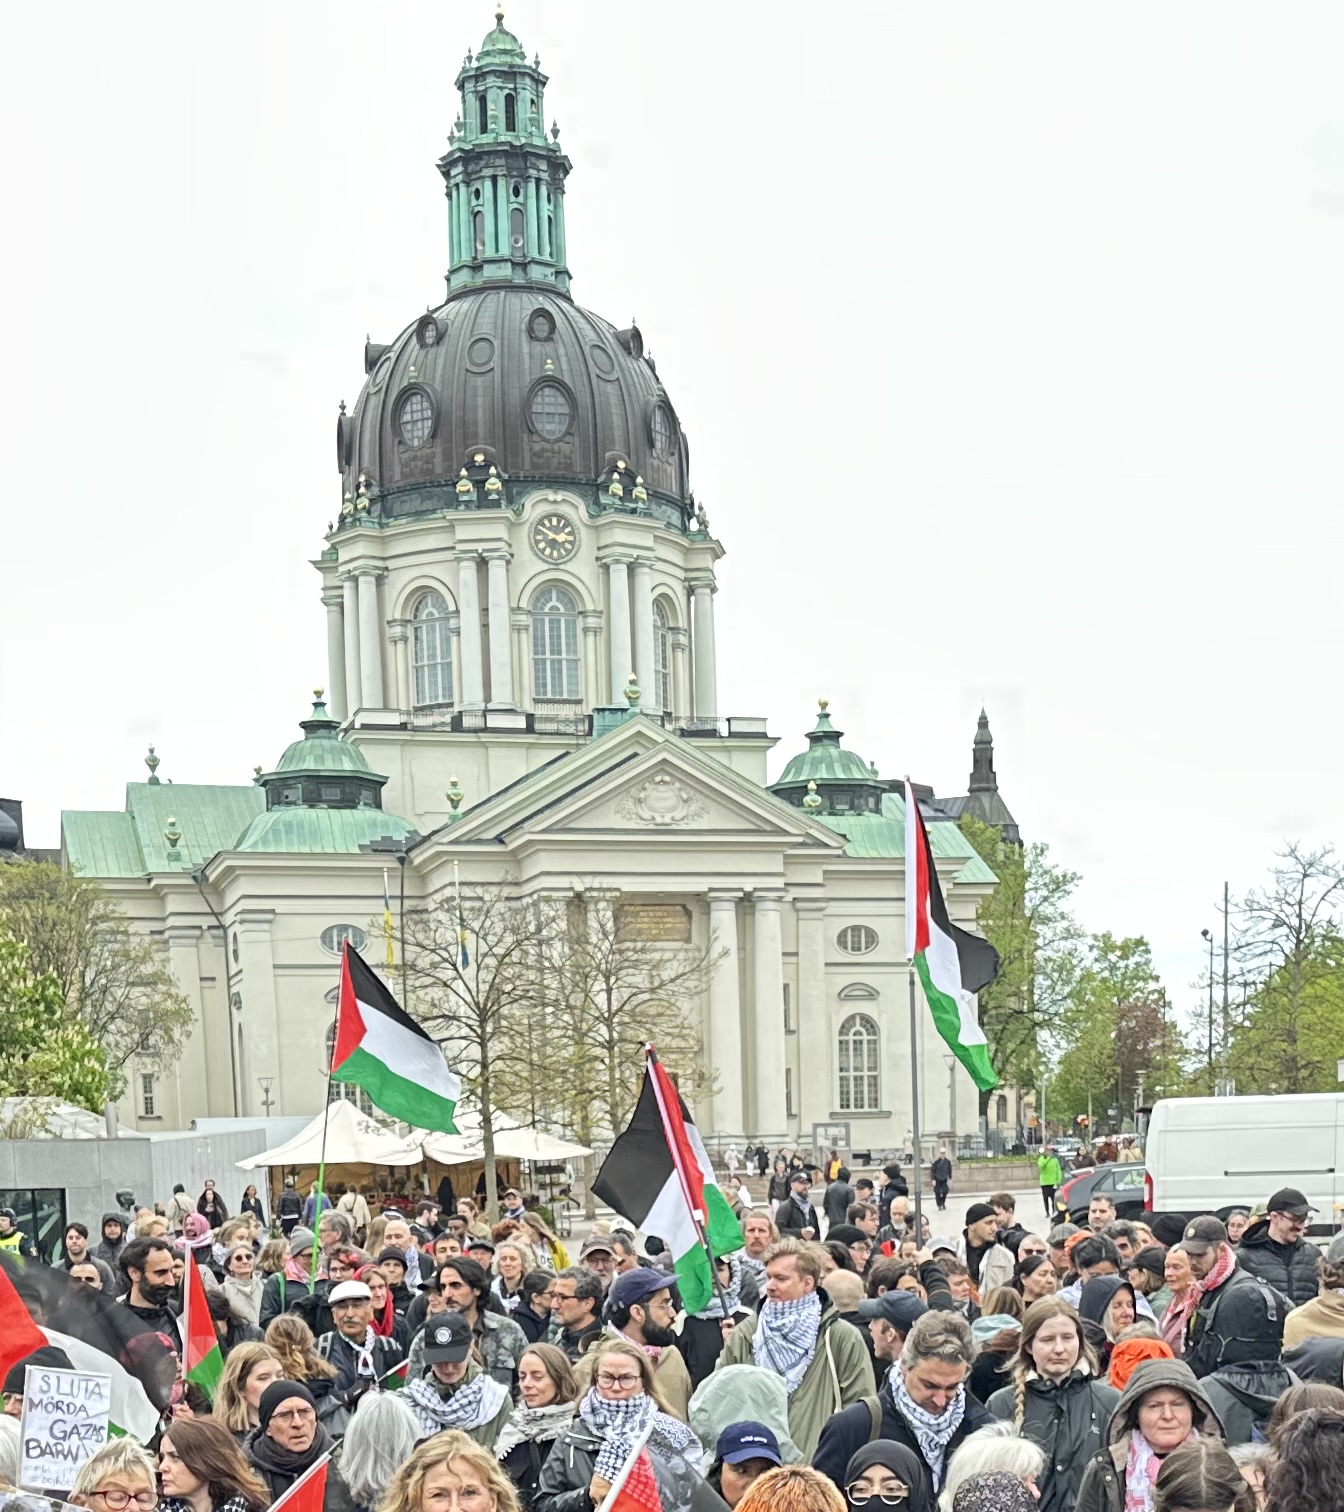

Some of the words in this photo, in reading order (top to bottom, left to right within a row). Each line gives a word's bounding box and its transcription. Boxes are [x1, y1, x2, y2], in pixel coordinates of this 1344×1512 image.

[39, 1374, 103, 1400] SLUTA
[28, 1396, 89, 1419] MÖRDA
[49, 1419, 106, 1443] GAZAS
